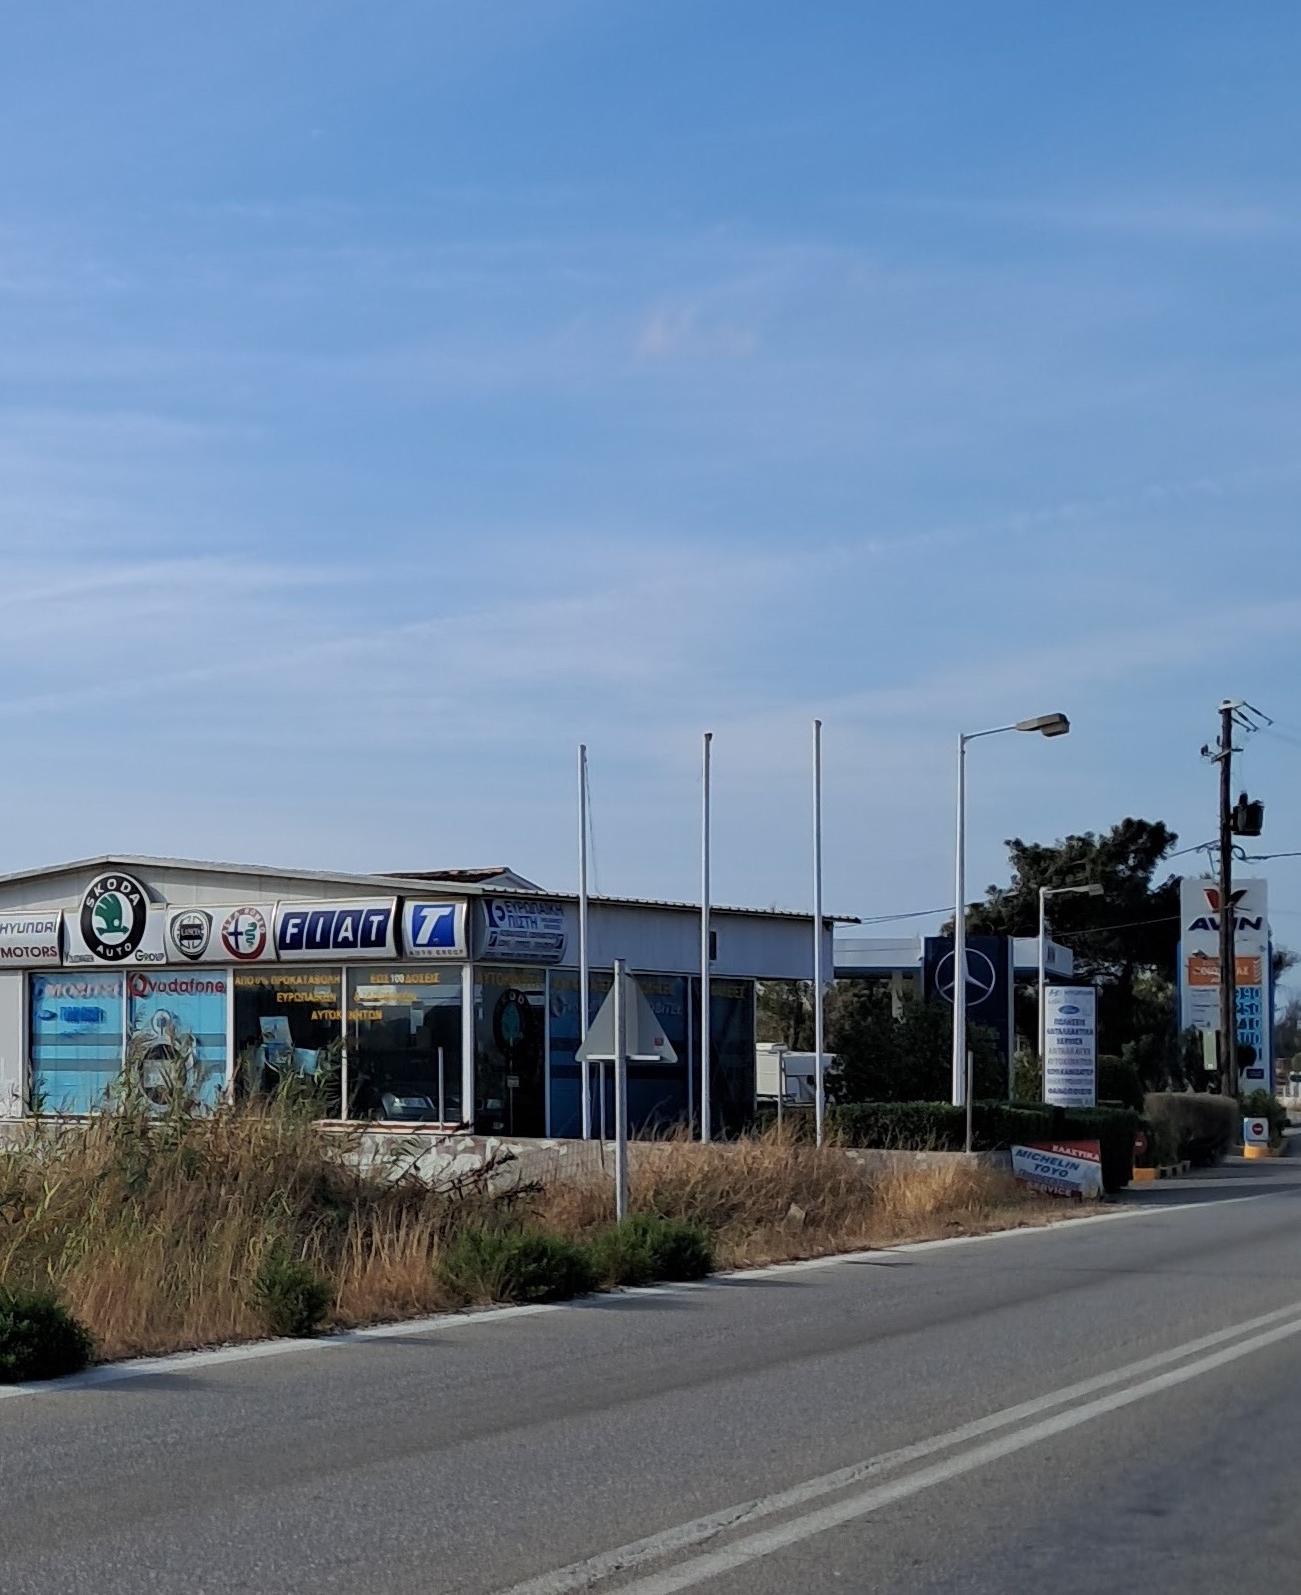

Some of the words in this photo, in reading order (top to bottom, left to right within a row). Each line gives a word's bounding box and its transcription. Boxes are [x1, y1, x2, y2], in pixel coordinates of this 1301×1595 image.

[85, 878, 141, 908] SKODA
[285, 915, 384, 944] FIAT
[0, 946, 58, 959] MOTORS
[96, 942, 132, 957] AUTO
[149, 978, 225, 993] vodafone
[1015, 1149, 1081, 1171] MICHELIN
[1052, 1144, 1100, 1162] ΕΛΑΣΤΙΚΑ
[1034, 1162, 1069, 1178] TOYO
